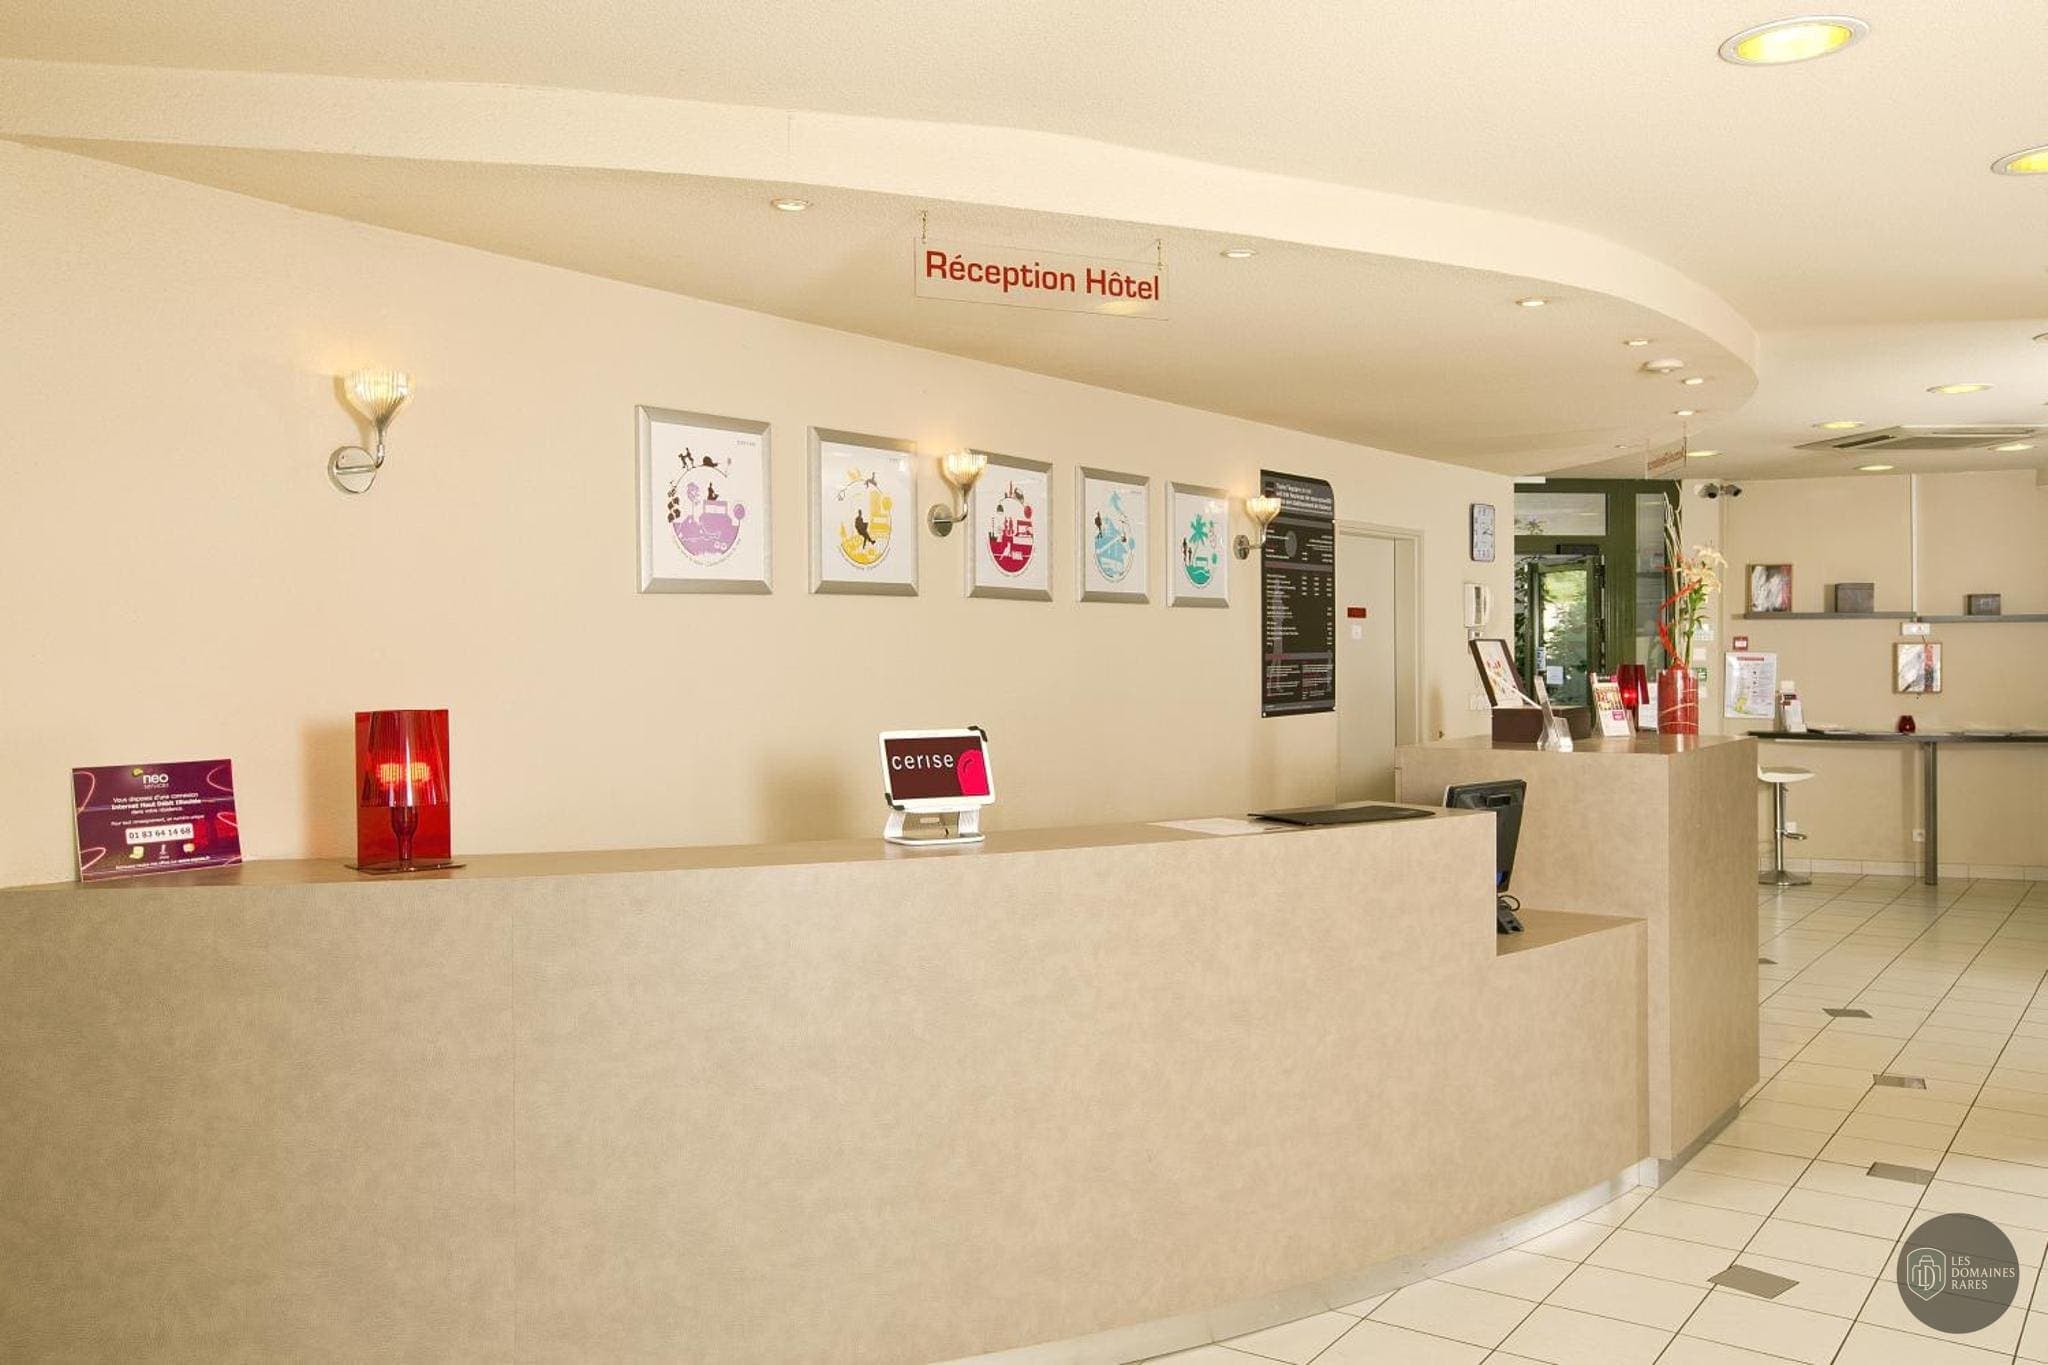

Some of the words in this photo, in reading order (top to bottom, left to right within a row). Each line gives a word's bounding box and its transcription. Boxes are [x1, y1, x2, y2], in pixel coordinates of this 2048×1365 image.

[926, 250, 1075, 293] Réception
[1086, 268, 1160, 301] Hôtel
[891, 753, 954, 770] cerise
[143, 774, 169, 784] neo
